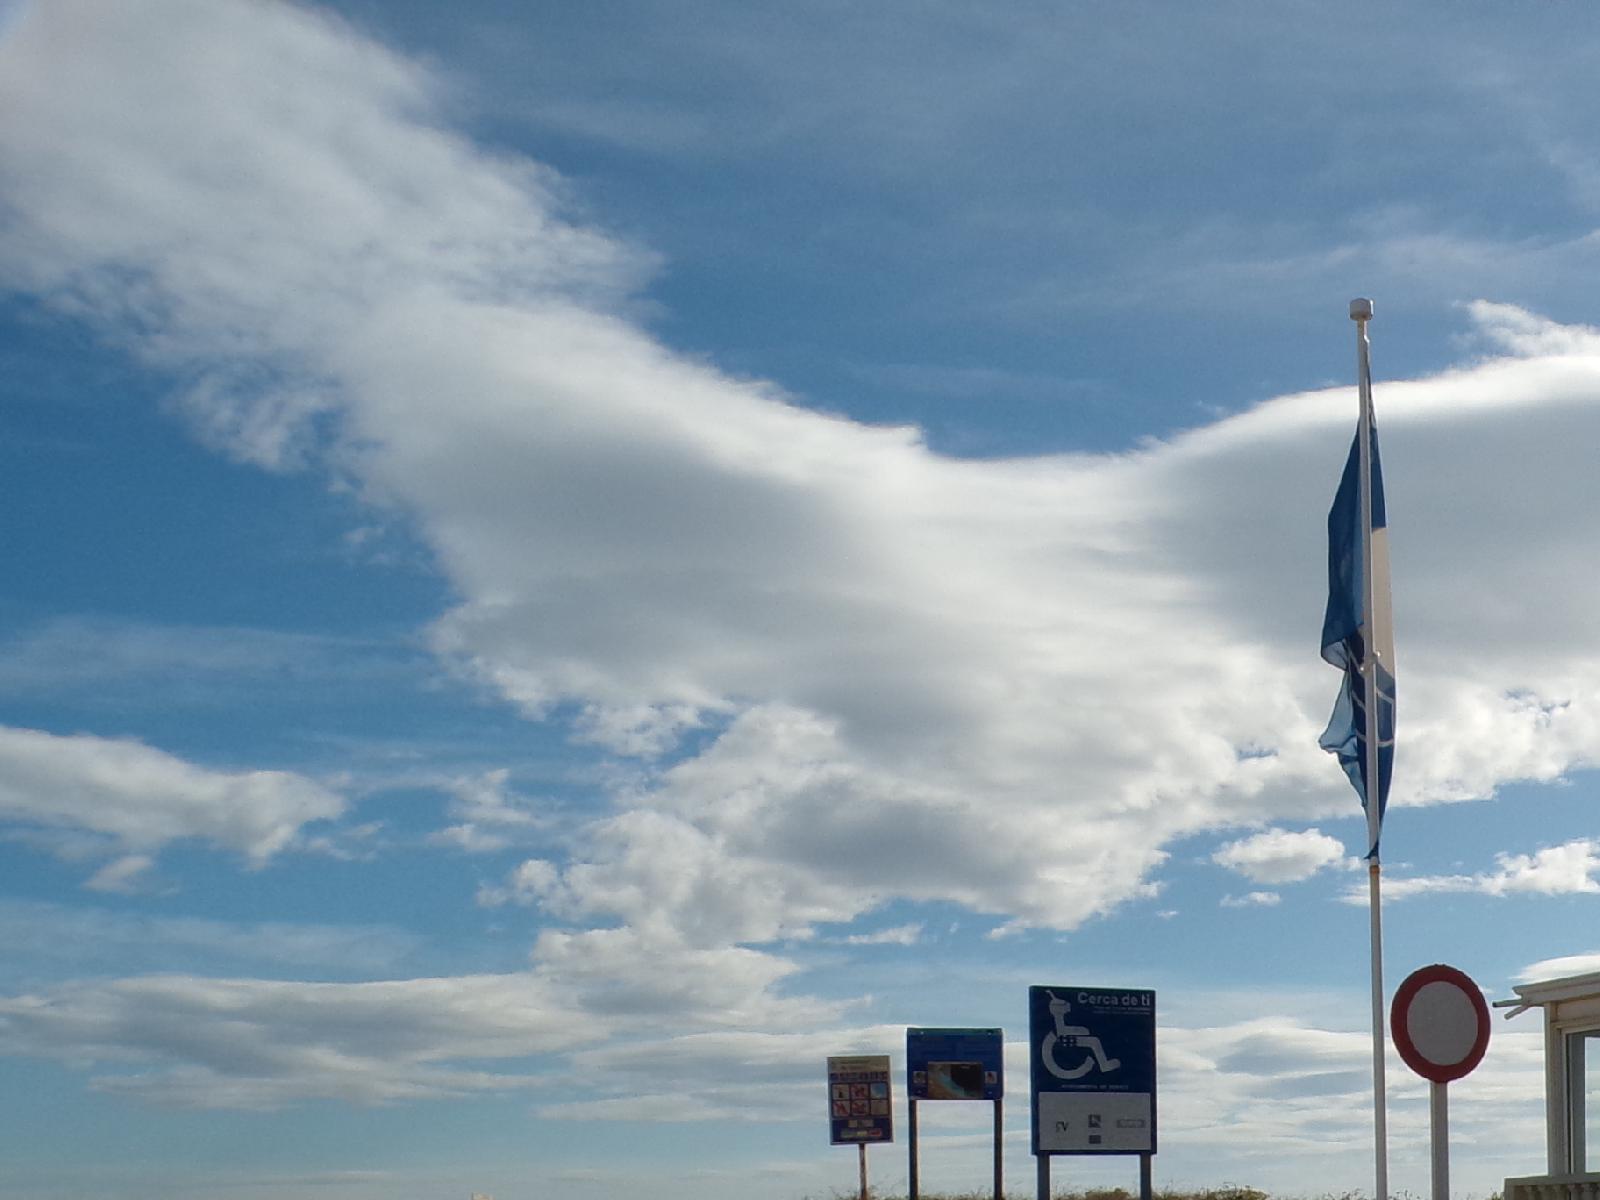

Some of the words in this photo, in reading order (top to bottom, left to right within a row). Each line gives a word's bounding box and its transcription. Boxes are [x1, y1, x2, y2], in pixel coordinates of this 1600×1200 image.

[1078, 991, 1119, 1005] Cerca
[1121, 993, 1138, 1005] de
[1141, 994, 1151, 1006] ti
